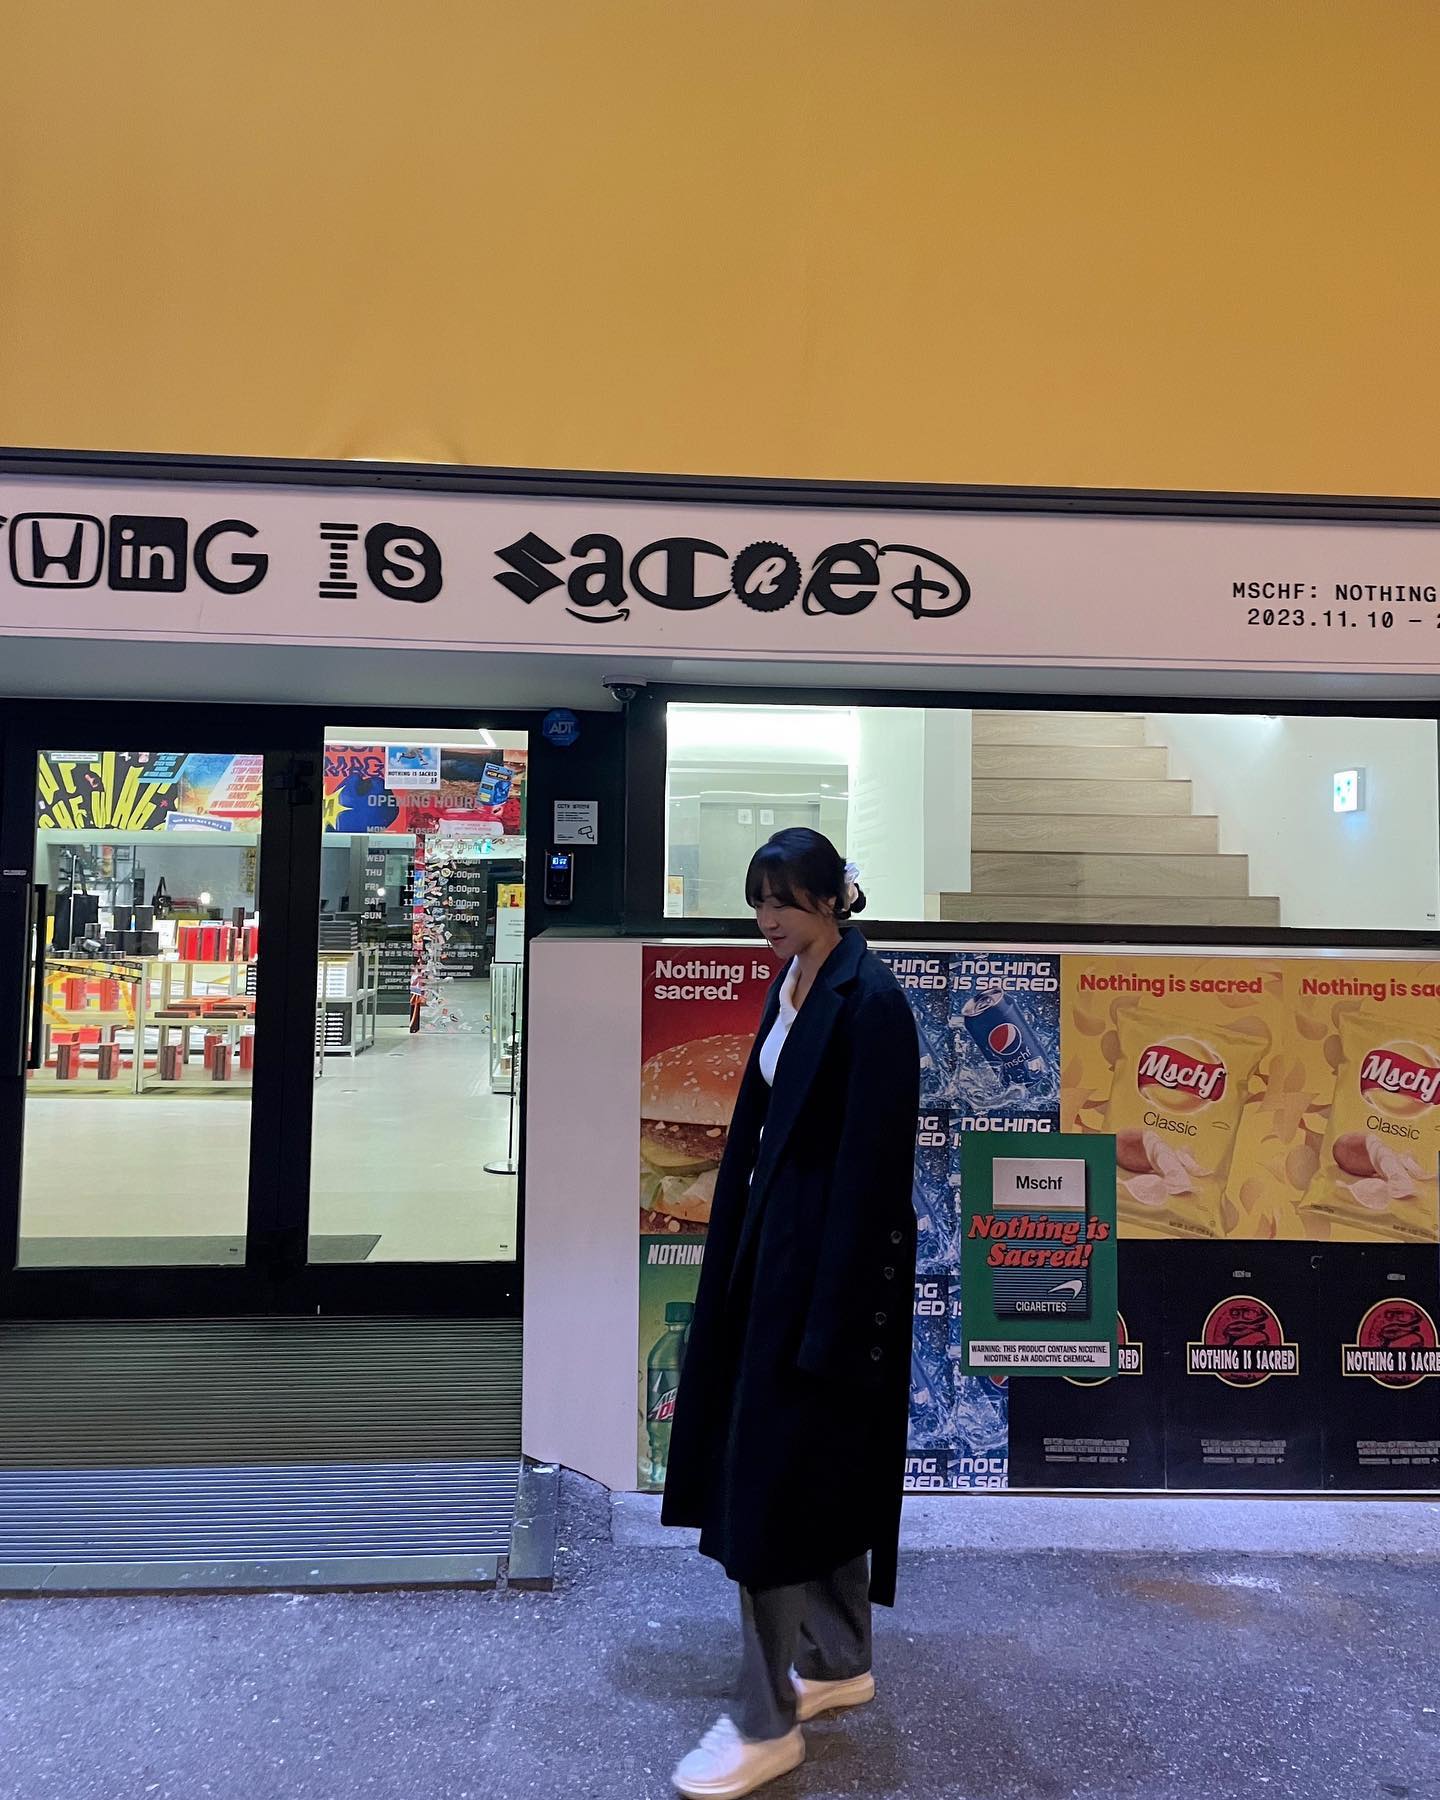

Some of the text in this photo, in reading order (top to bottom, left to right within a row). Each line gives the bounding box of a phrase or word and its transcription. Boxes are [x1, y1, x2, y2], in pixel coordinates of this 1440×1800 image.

[1232, 582, 1437, 602] MSCHF: NOTHING
[1247, 608, 1394, 628] 2023.11.10
[549, 721, 575, 734] ADT
[367, 794, 432, 808] OPENING
[449, 871, 481, 880] 7:00pm
[364, 897, 379, 905] SAT
[448, 914, 480, 923] 7:00pm
[655, 960, 771, 983] Nothing is
[961, 960, 1051, 976] NOTHING
[654, 982, 738, 1000] sacred.
[953, 976, 1058, 992] IS SACRED
[1080, 973, 1263, 997] Nothing is sacred
[1301, 977, 1387, 1002] Nothing
[1390, 978, 1407, 997] is
[1003, 1045, 1033, 1070] mschf
[1139, 1050, 1227, 1099] Mschf
[961, 1117, 1051, 1133] NOTHING
[1143, 1111, 1198, 1137] Classic
[1366, 1115, 1421, 1140] Classic
[1016, 1175, 1063, 1191] Mschf
[968, 1214, 1111, 1246] Nothing is
[647, 1244, 705, 1265] NOTHIN
[986, 1241, 1094, 1269] Sacred!
[1015, 1301, 1068, 1313] CIGARETTES
[971, 1344, 1002, 1353] WARNING:
[1003, 1344, 1017, 1353] THIS
[1018, 1345, 1047, 1353] PRODUCT
[1047, 1345, 1077, 1354] CONTAINS
[983, 1354, 1012, 1363] NICOTINE
[1013, 1354, 1019, 1363] IS
[1019, 1354, 1029, 1363] AN
[1030, 1354, 1062, 1363] ADDICTIVE
[1191, 1349, 1296, 1371] NOTHING IS SACRED
[1346, 1351, 1394, 1371] NOTHING
[1398, 1351, 1407, 1371] IS
